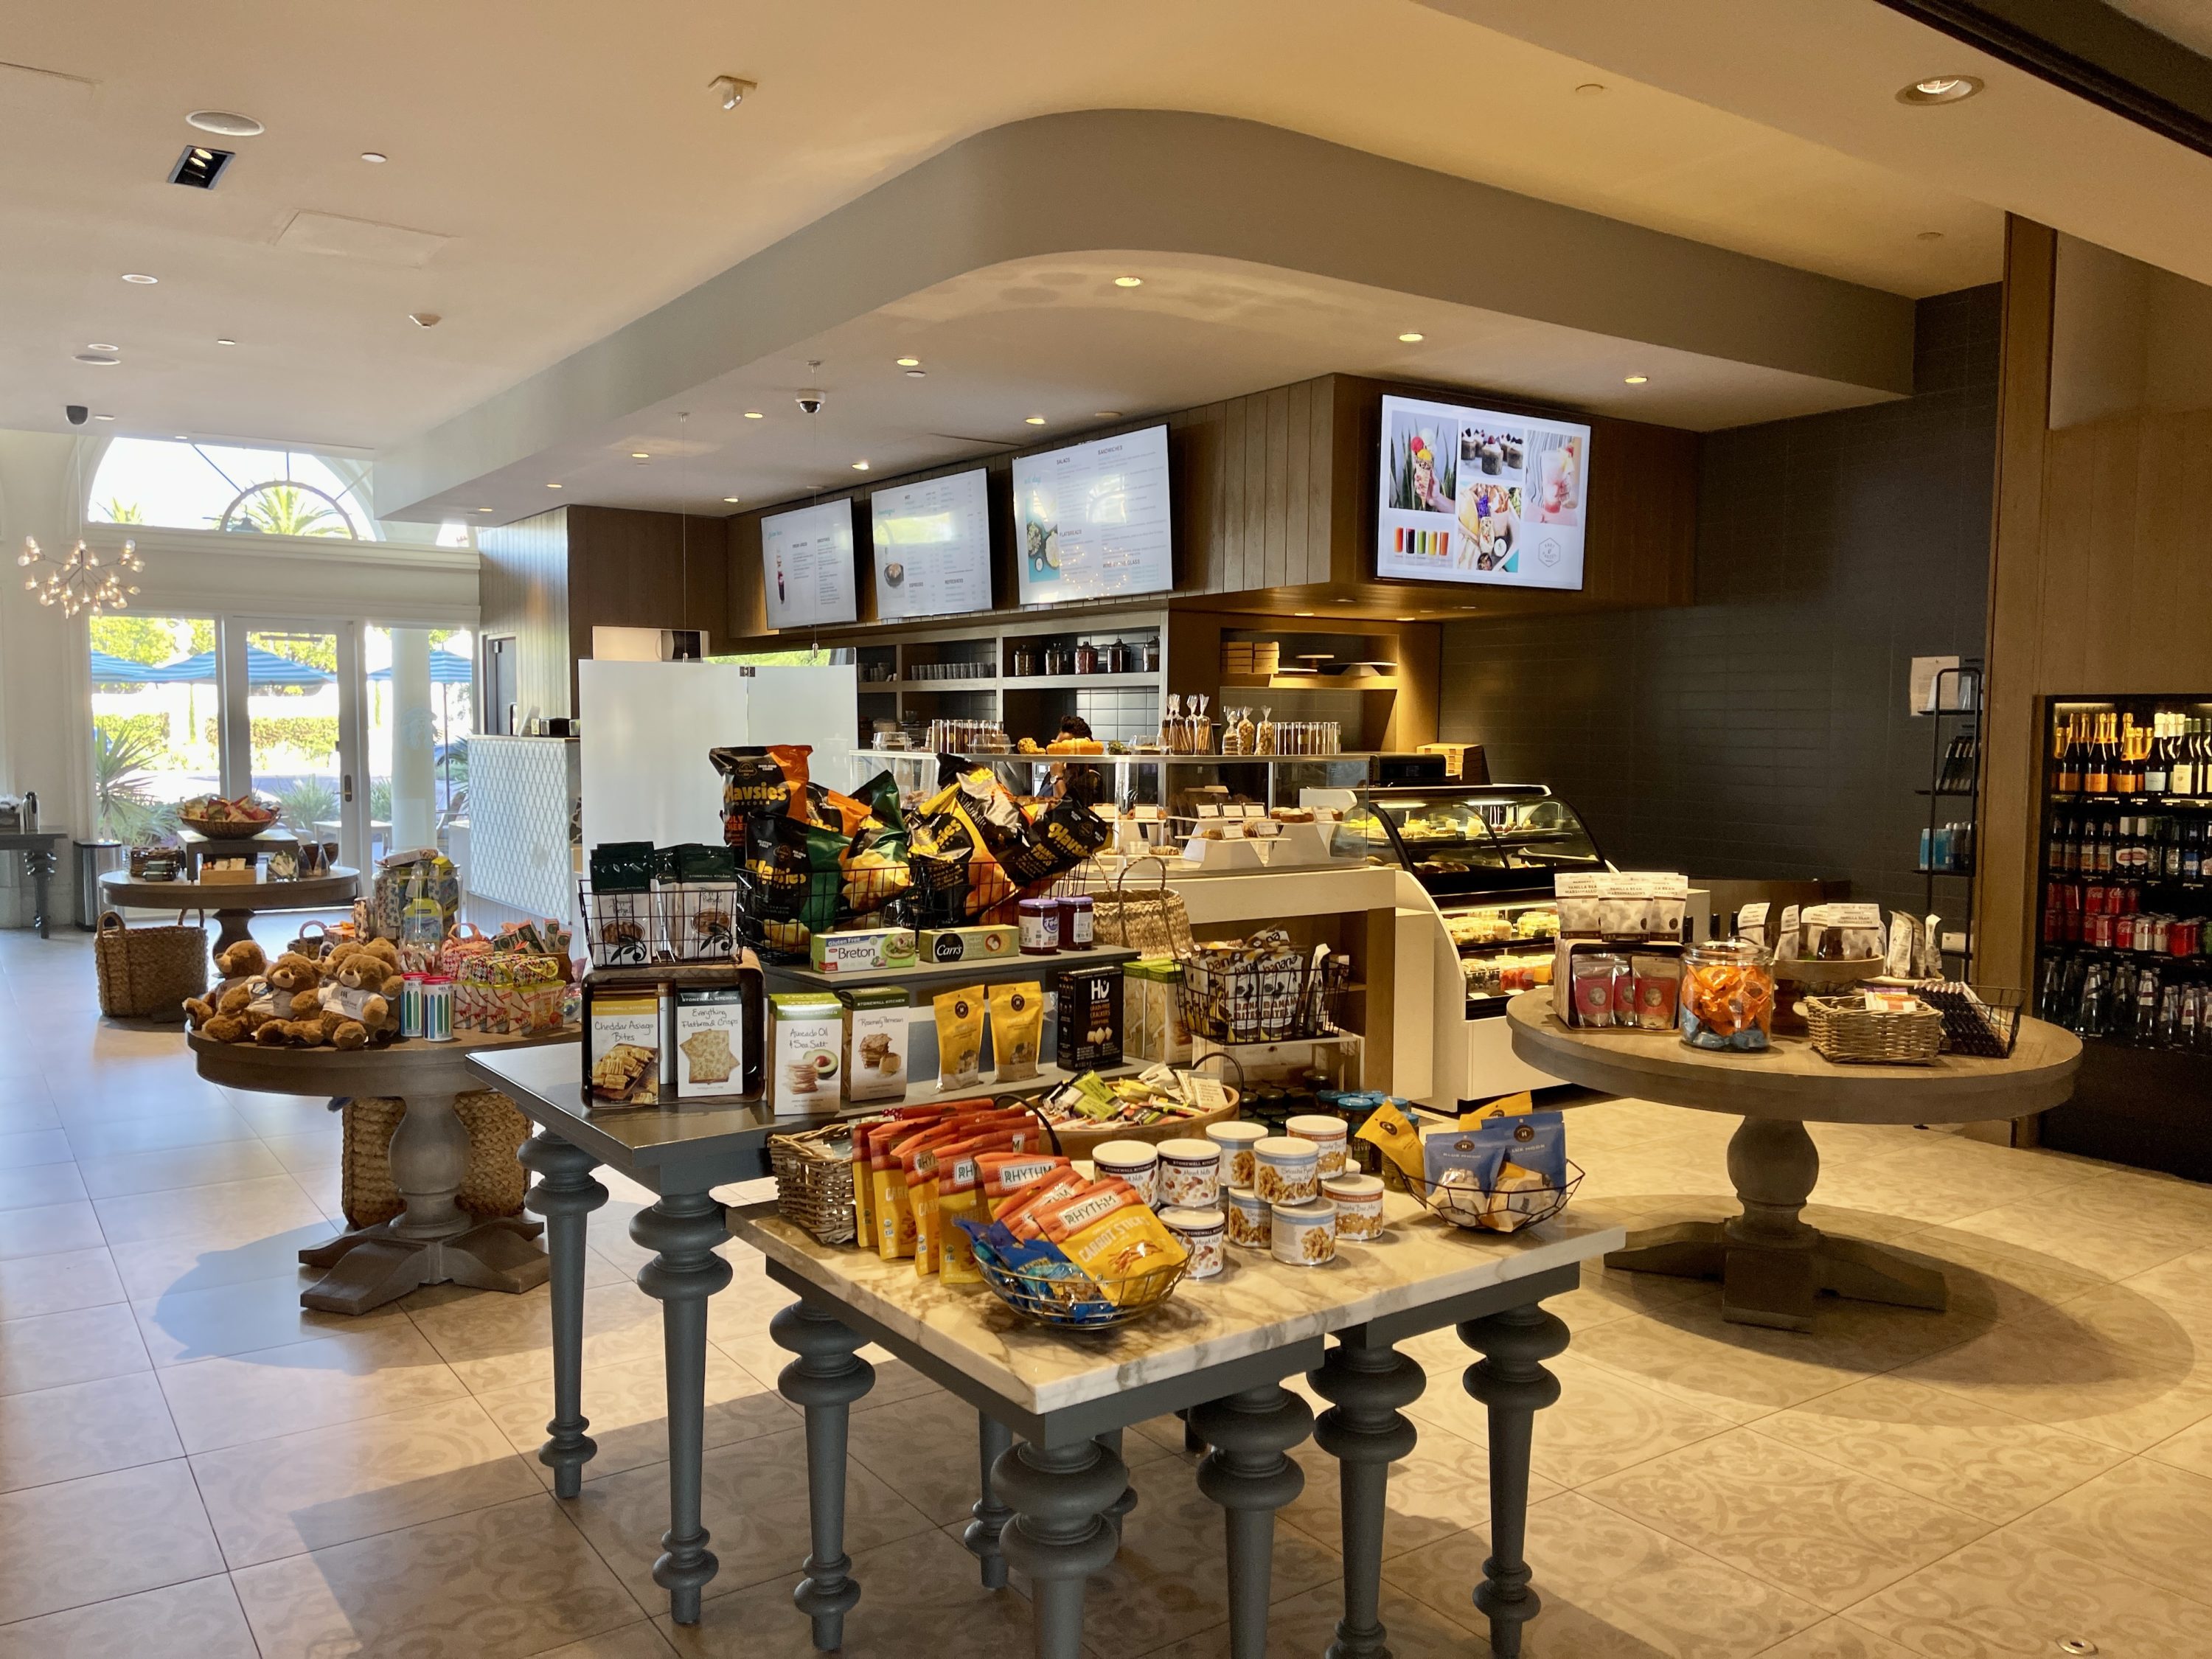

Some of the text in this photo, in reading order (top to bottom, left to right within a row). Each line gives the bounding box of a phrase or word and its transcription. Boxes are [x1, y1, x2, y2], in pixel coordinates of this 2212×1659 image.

[827, 936, 861, 947] Gluten Free
[838, 947, 875, 959] Breton
[936, 945, 962, 956] Carr's
[692, 1008, 727, 1020] Everything
[594, 1020, 654, 1036] Cheddar Asiago
[681, 1020, 715, 1029] Flatbread
[611, 1032, 635, 1043] Bites
[790, 1027, 829, 1037] Avocado Oil
[793, 1040, 809, 1048] Sea
[810, 1040, 829, 1048] Salt
[1004, 1166, 1051, 1183] RHYTHM
[1064, 1195, 1117, 1225] RHYTHM
[1079, 1228, 1116, 1263] CARROT
[1116, 1215, 1151, 1235] STICKS
